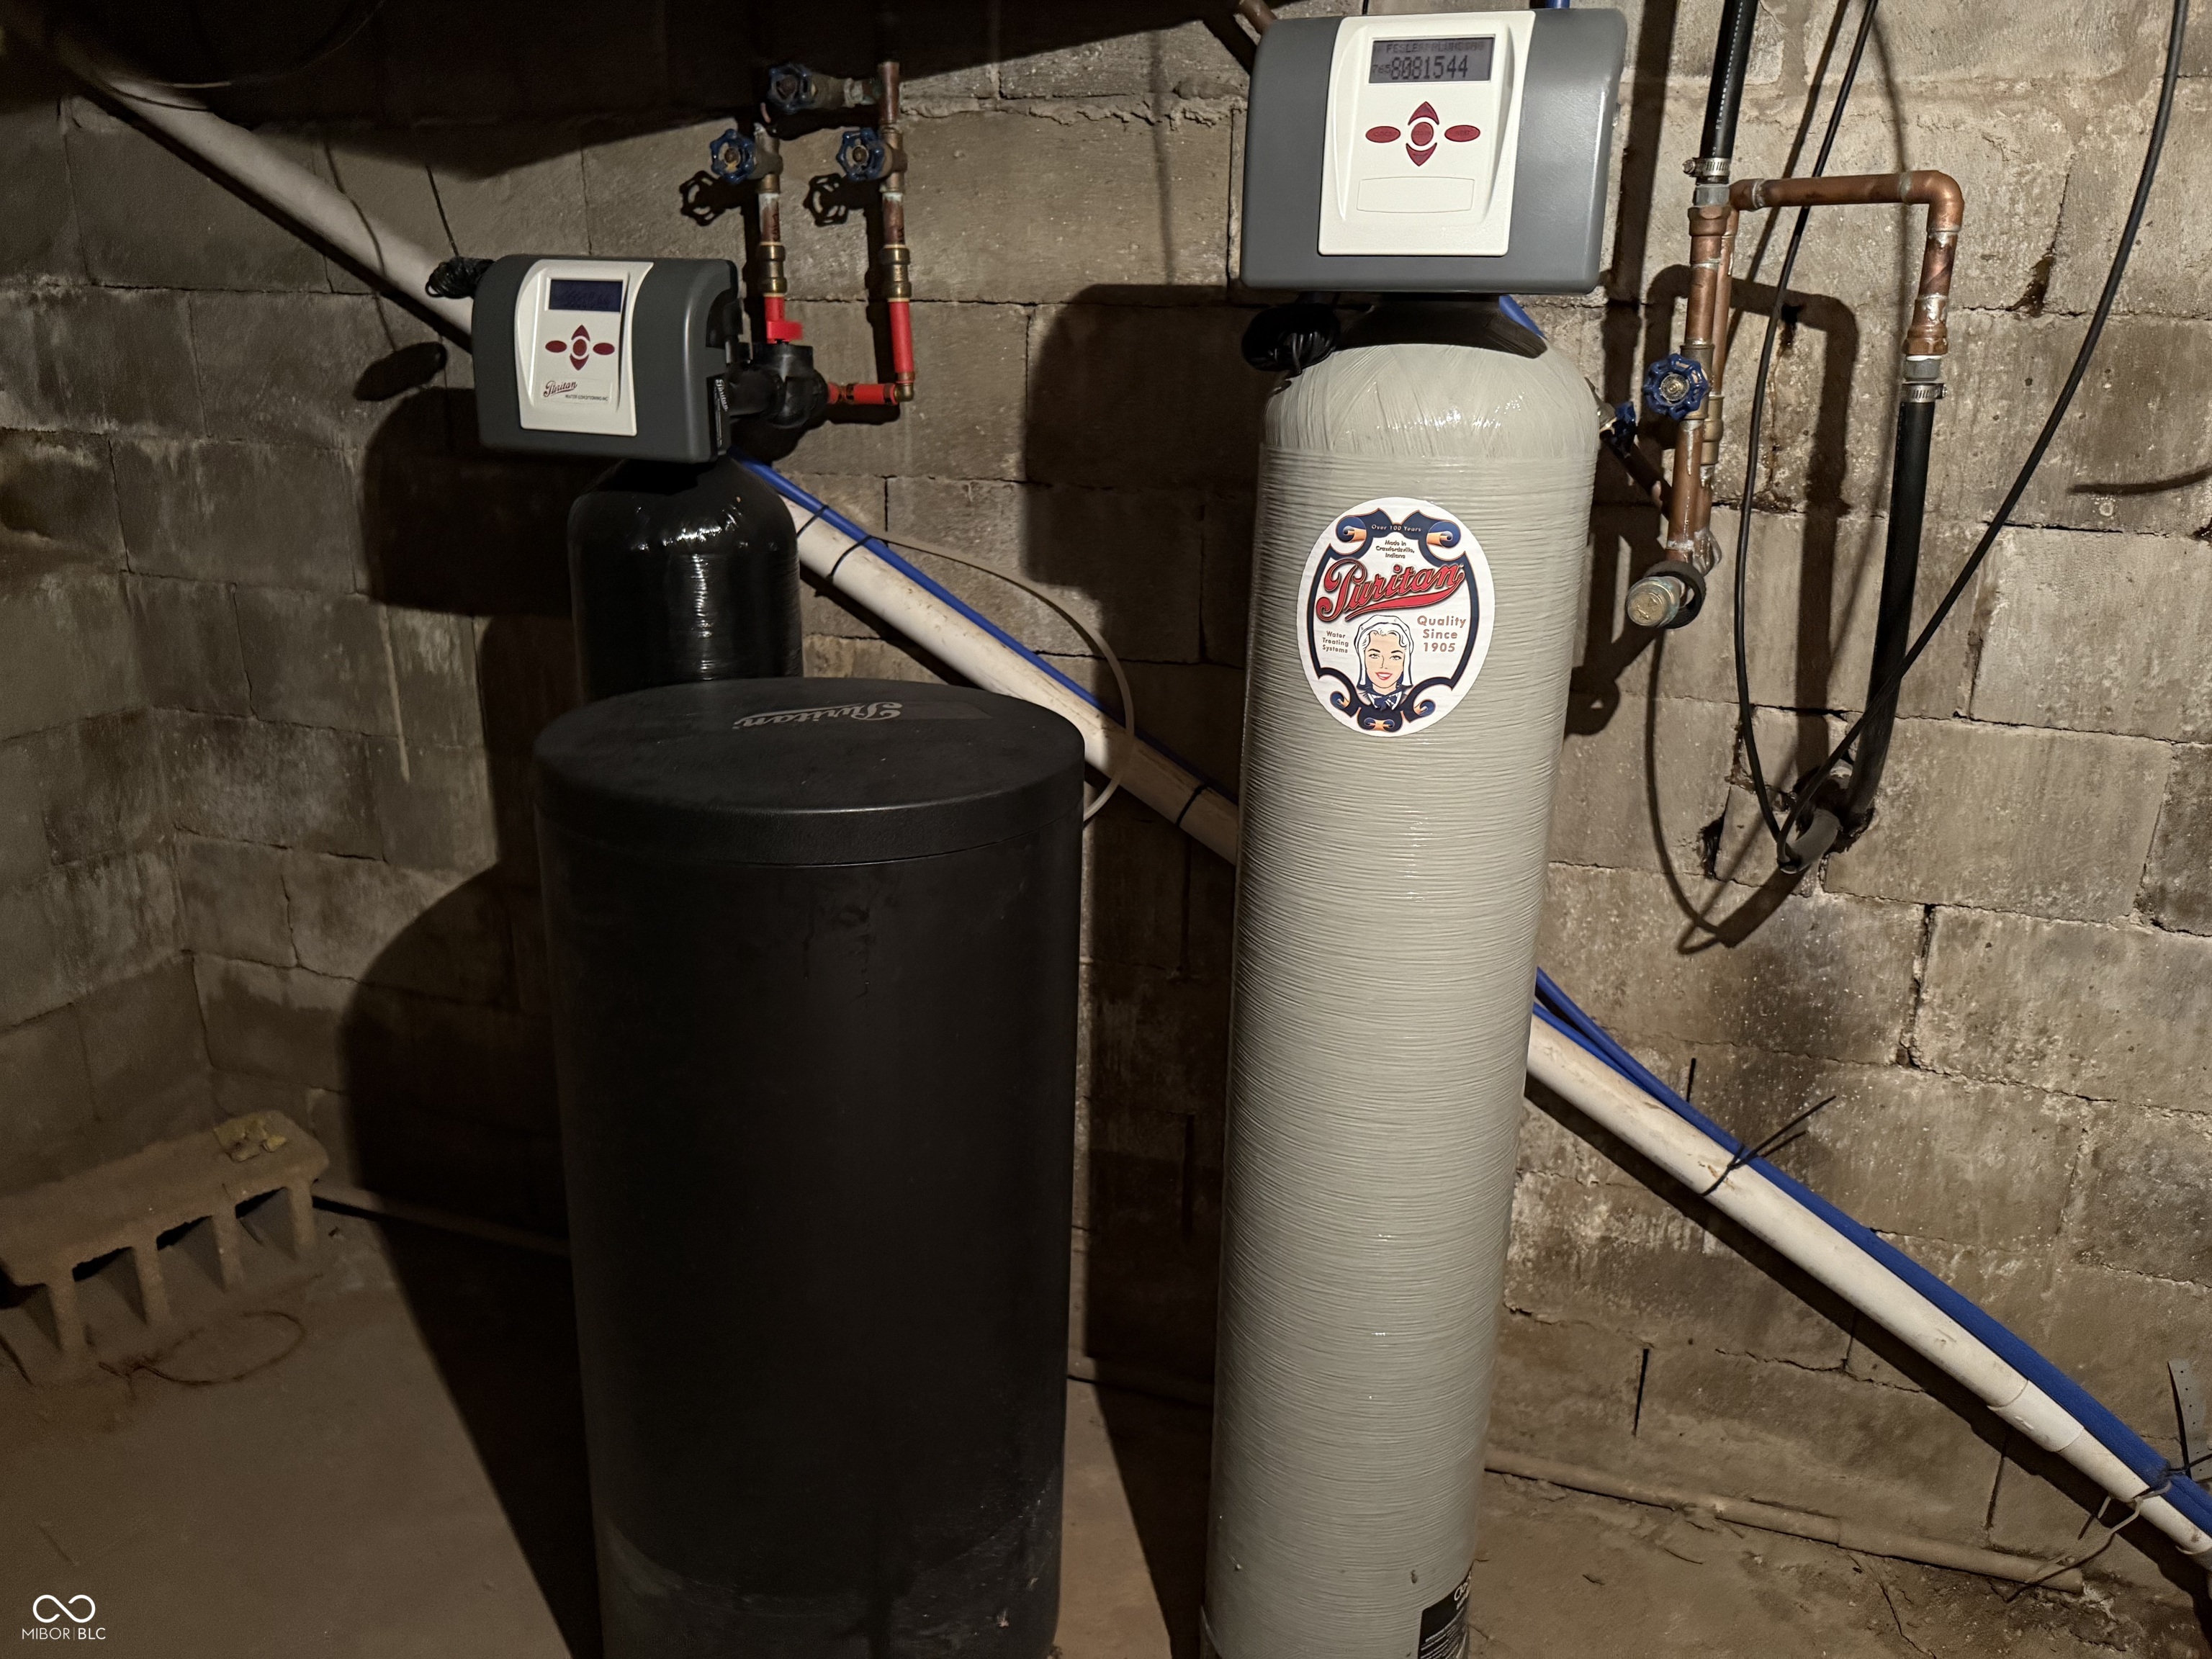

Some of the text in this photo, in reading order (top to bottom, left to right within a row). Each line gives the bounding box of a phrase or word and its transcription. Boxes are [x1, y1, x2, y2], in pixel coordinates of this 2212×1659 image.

[543, 380, 578, 397] Puritan
[1316, 557, 1465, 621] Puritan
[1417, 616, 1467, 628] Quality
[1423, 629, 1458, 639] Since
[1322, 637, 1349, 647] Treating
[1424, 642, 1456, 652] 1905
[1322, 644, 1348, 653] Systems
[733, 701, 903, 729] Puritan
